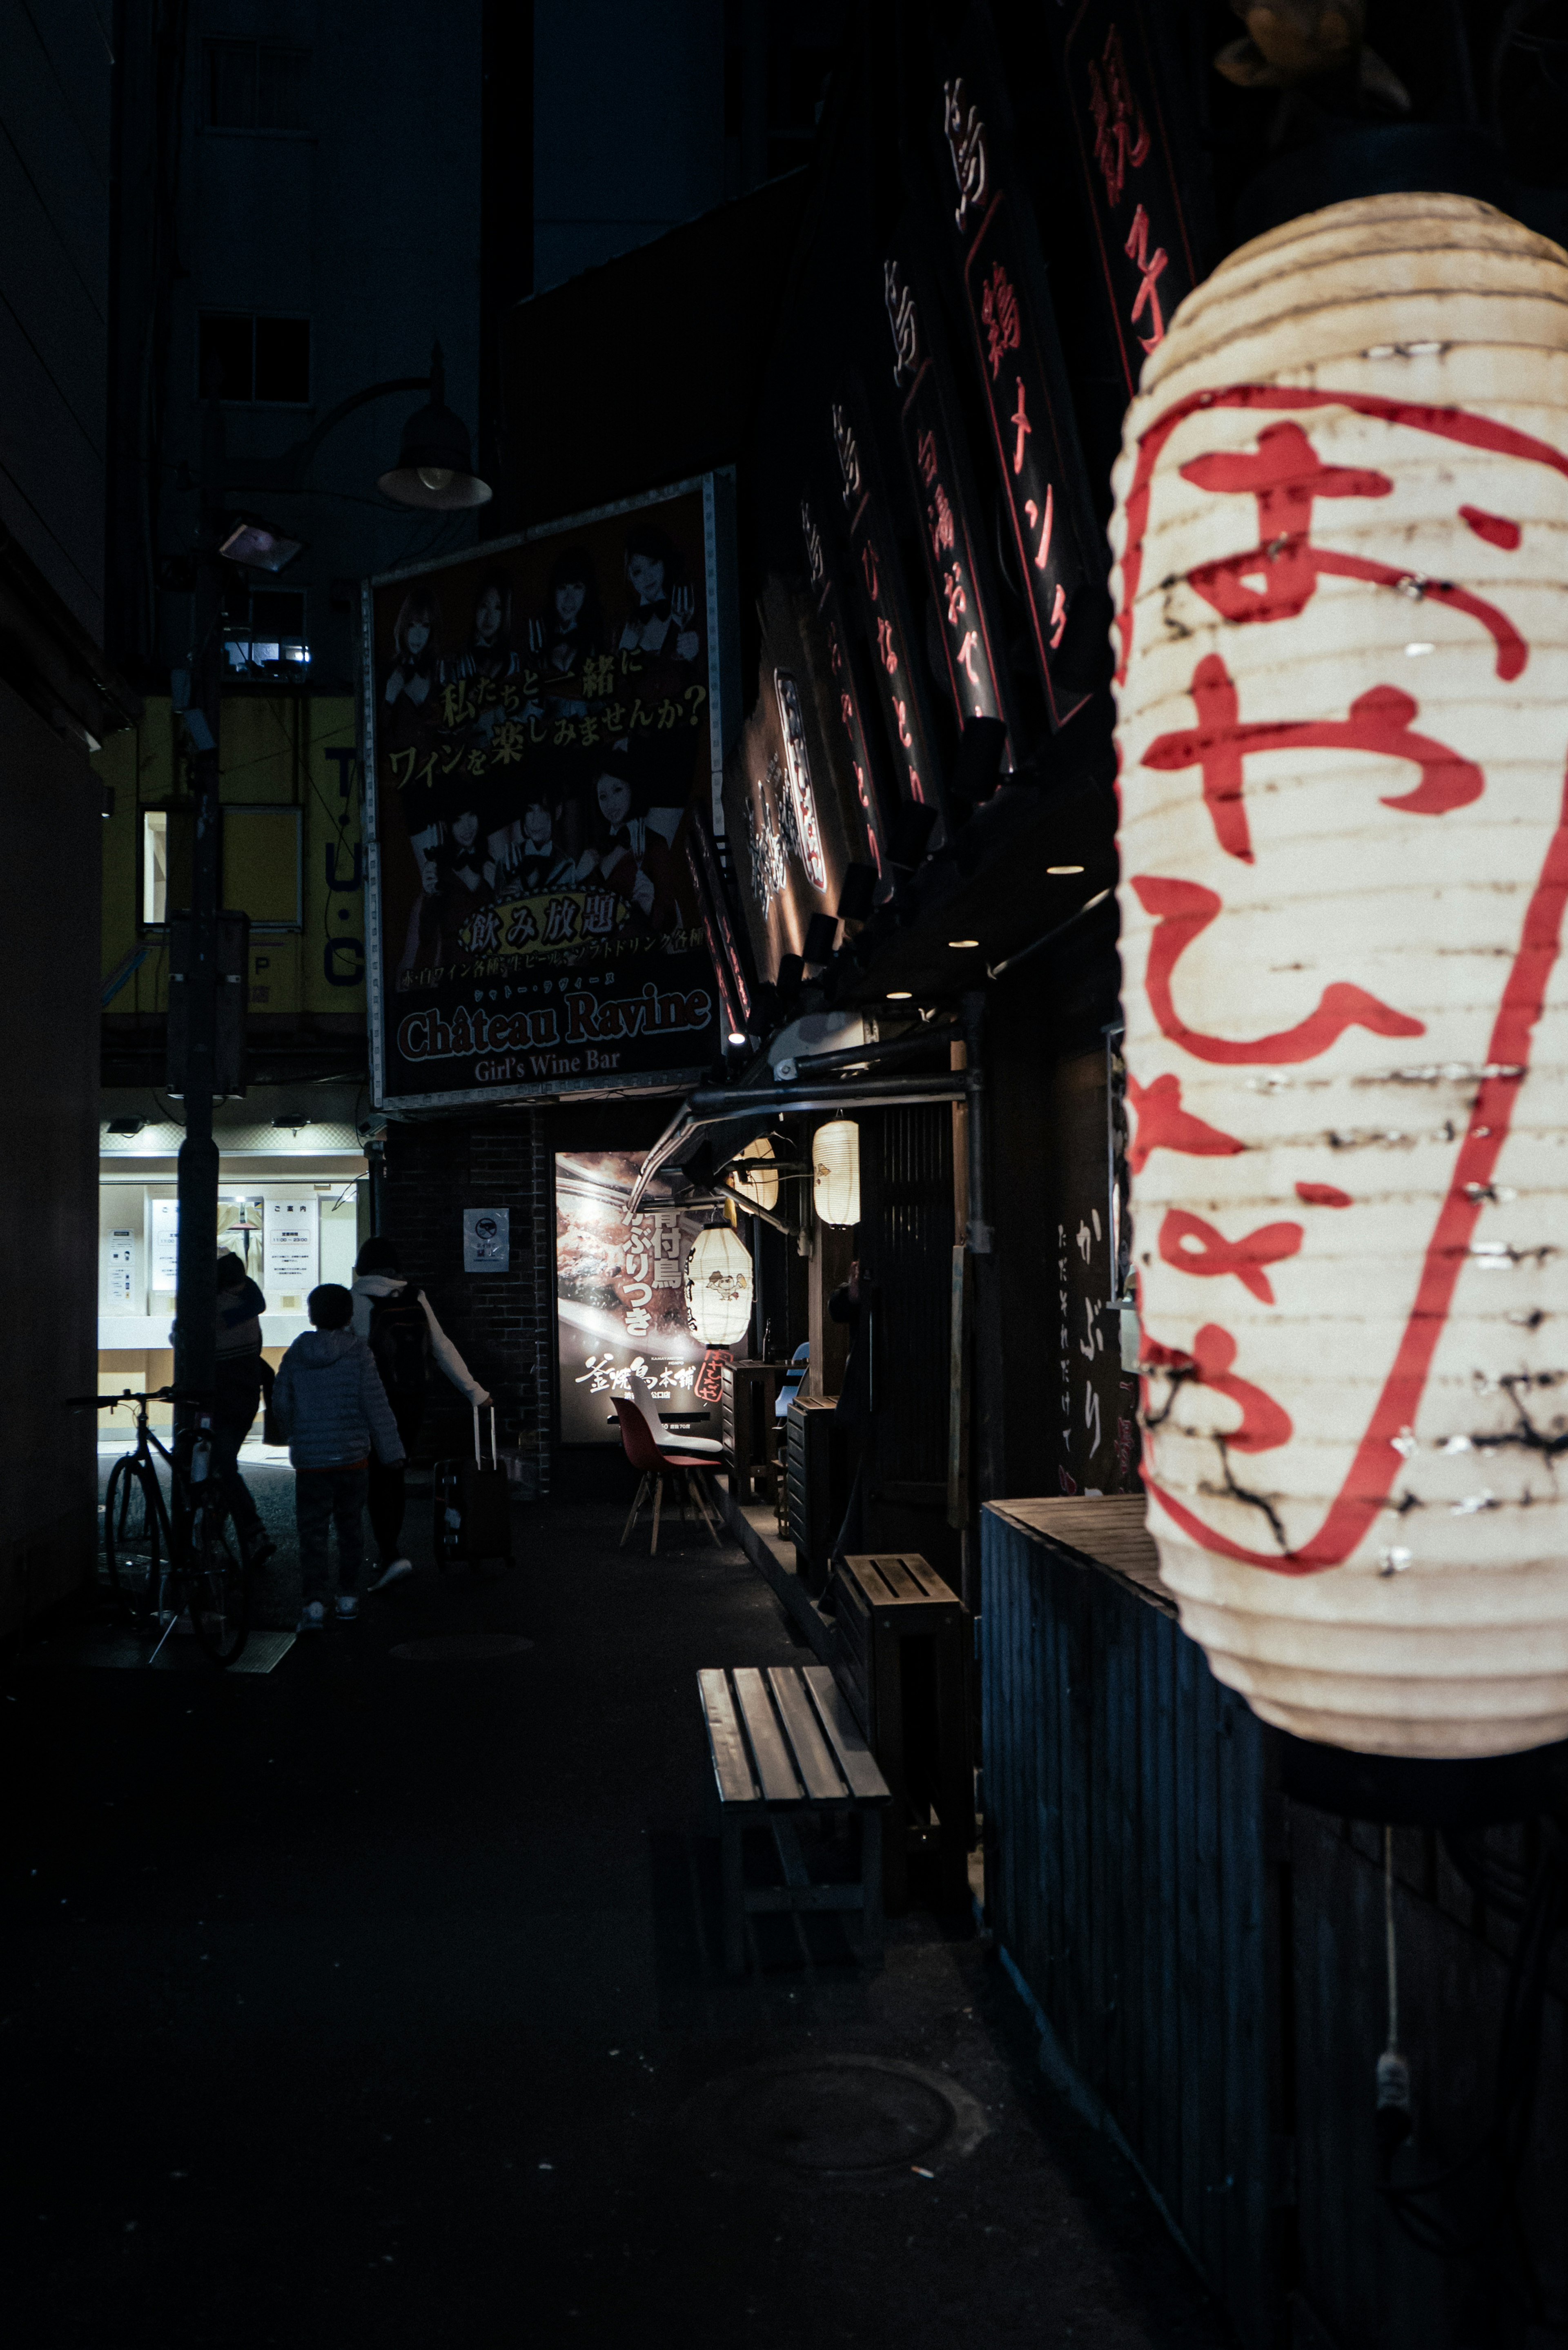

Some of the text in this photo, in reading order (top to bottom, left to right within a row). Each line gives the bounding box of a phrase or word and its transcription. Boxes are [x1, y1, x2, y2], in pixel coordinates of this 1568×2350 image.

[439, 648, 644, 728] 私たちと一緒に
[388, 684, 707, 790] ワインを楽しみませんか？
[468, 894, 618, 952] 飲み放題
[1126, 421, 1528, 1453] おやひなや
[397, 982, 712, 1061] Château Ravine
[474, 1049, 621, 1083] Girl's Wine Bar
[575, 1353, 696, 1393] 釜焼鳥本舗
[1076, 1208, 1103, 1496] かぶり
